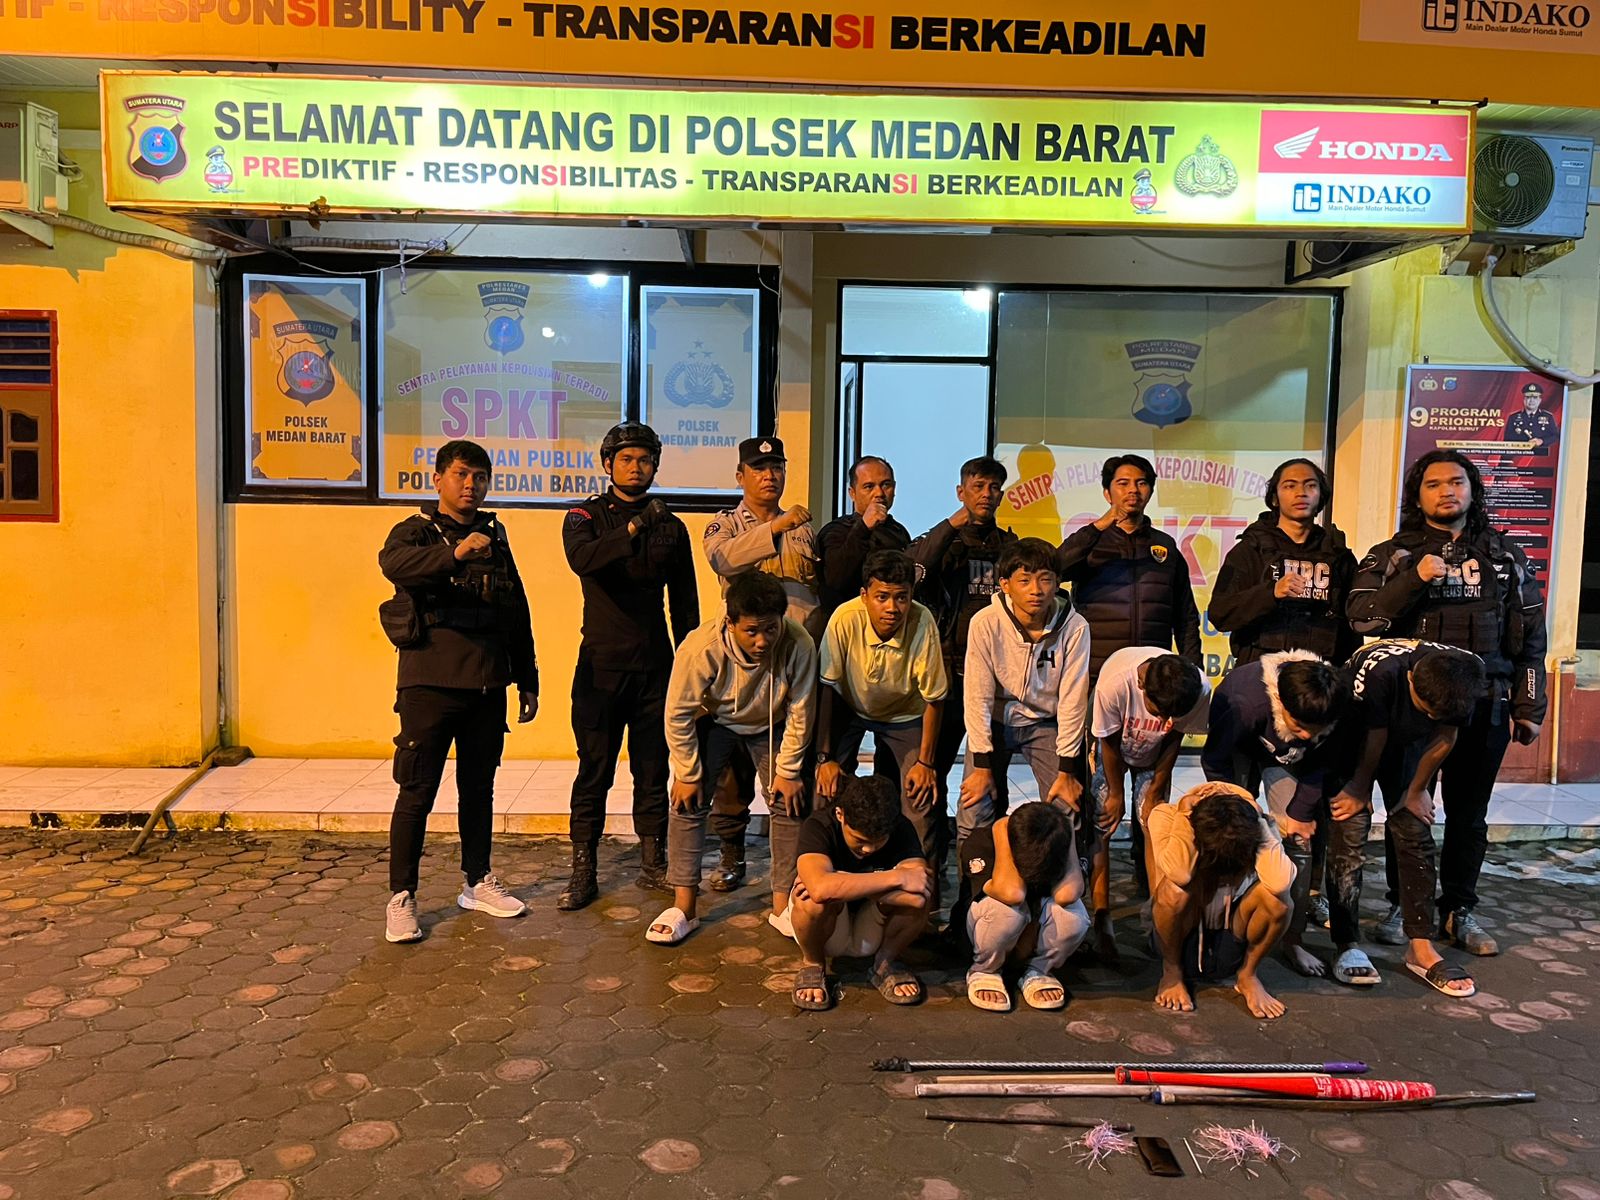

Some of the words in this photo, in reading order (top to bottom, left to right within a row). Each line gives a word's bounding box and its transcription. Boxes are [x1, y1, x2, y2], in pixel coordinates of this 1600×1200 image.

[1463, 0, 1591, 28] INDAKO
[97, 0, 486, 34] RESPONSIBILITY
[523, 3, 875, 49] TRANSPARANSI
[890, 16, 1206, 58] BERKEADILAN
[1465, 23, 1484, 31] Main
[1485, 24, 1509, 33] Dealer
[1510, 26, 1532, 34] Motor
[1533, 27, 1558, 36] Honda
[1559, 28, 1583, 38] Sumut
[128, 97, 162, 108] SUMATERA
[162, 98, 184, 109] UTARA
[213, 101, 423, 146] SELAMAT
[438, 108, 614, 152] DATANG
[629, 113, 670, 154] DI
[686, 115, 858, 159] POLSEK
[871, 120, 1021, 161] MEDAN
[1035, 123, 1176, 164] BARAT
[1318, 141, 1453, 162] HONDA
[243, 156, 397, 181] PREDIKTIF
[423, 162, 678, 190] RESPONSIBILITAS
[701, 169, 918, 195] TRANSPARANSI
[927, 174, 1123, 198] BERKEADILAN
[1327, 185, 1432, 205] INDAKO
[275, 322, 313, 336] SUMATERA
[312, 323, 336, 338] UTARA
[1134, 361, 1169, 369] SUMATERA
[397, 374, 437, 396] SENTRA
[439, 362, 498, 382] PELAYANAN
[502, 362, 562, 382] KEPOLISIAN
[564, 373, 609, 402] TERPADU
[441, 386, 568, 440] SPKT
[1410, 407, 1429, 428] 9
[1430, 407, 1501, 417] PROGRAM
[284, 415, 328, 428] POLSEK
[678, 419, 720, 432] POLSEK
[1429, 418, 1505, 428] PRIORITAS
[266, 430, 307, 443] MEDAN
[310, 431, 347, 444] BARAT
[660, 434, 698, 446] MEDAN
[702, 435, 737, 447] BARAT
[527, 450, 594, 469] PUBLIK
[549, 475, 609, 494] BARAT
[1006, 469, 1064, 512] SENTRA
[1155, 456, 1239, 489] KEPOLISIAN
[1312, 588, 1329, 600] CEPAT
[1463, 585, 1482, 598] CEPAT
